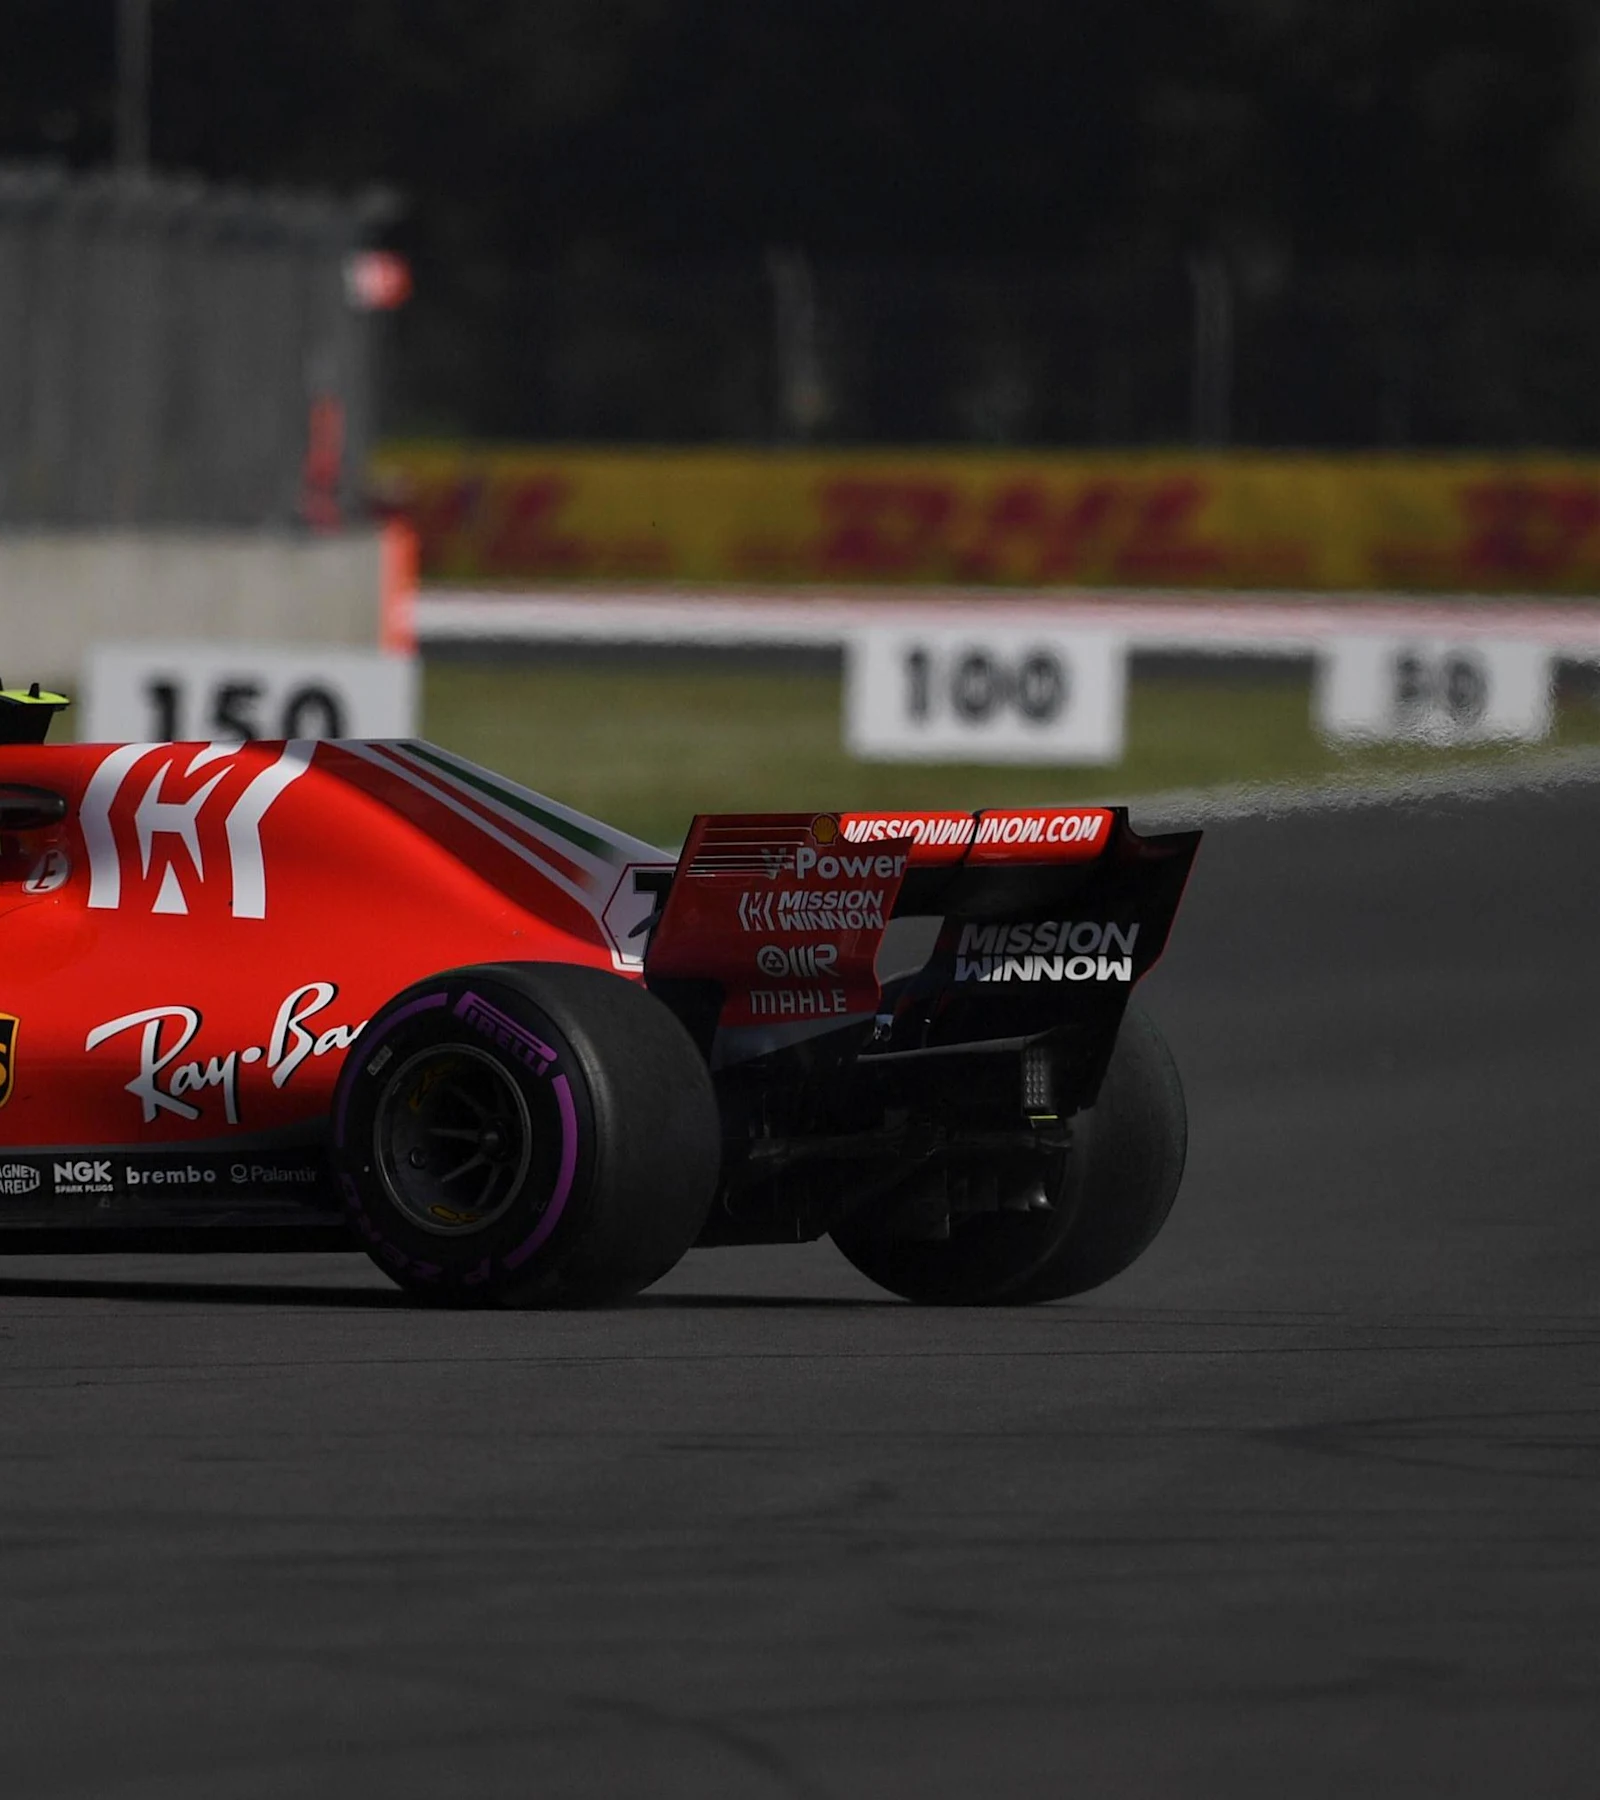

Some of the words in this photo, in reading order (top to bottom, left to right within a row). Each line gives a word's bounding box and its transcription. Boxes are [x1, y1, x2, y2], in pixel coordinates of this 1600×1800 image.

[902, 650, 1068, 726] 100
[843, 814, 1103, 846] MISSIONWINNOW.COM
[777, 889, 885, 910] MISSION
[777, 910, 885, 931] WINNOW
[957, 920, 1141, 956] MISSION
[954, 955, 1133, 982] WINNOW
[750, 988, 848, 1015] MAHLE
[53, 1160, 113, 1184] NGK
[126, 1165, 217, 1186] brembo
